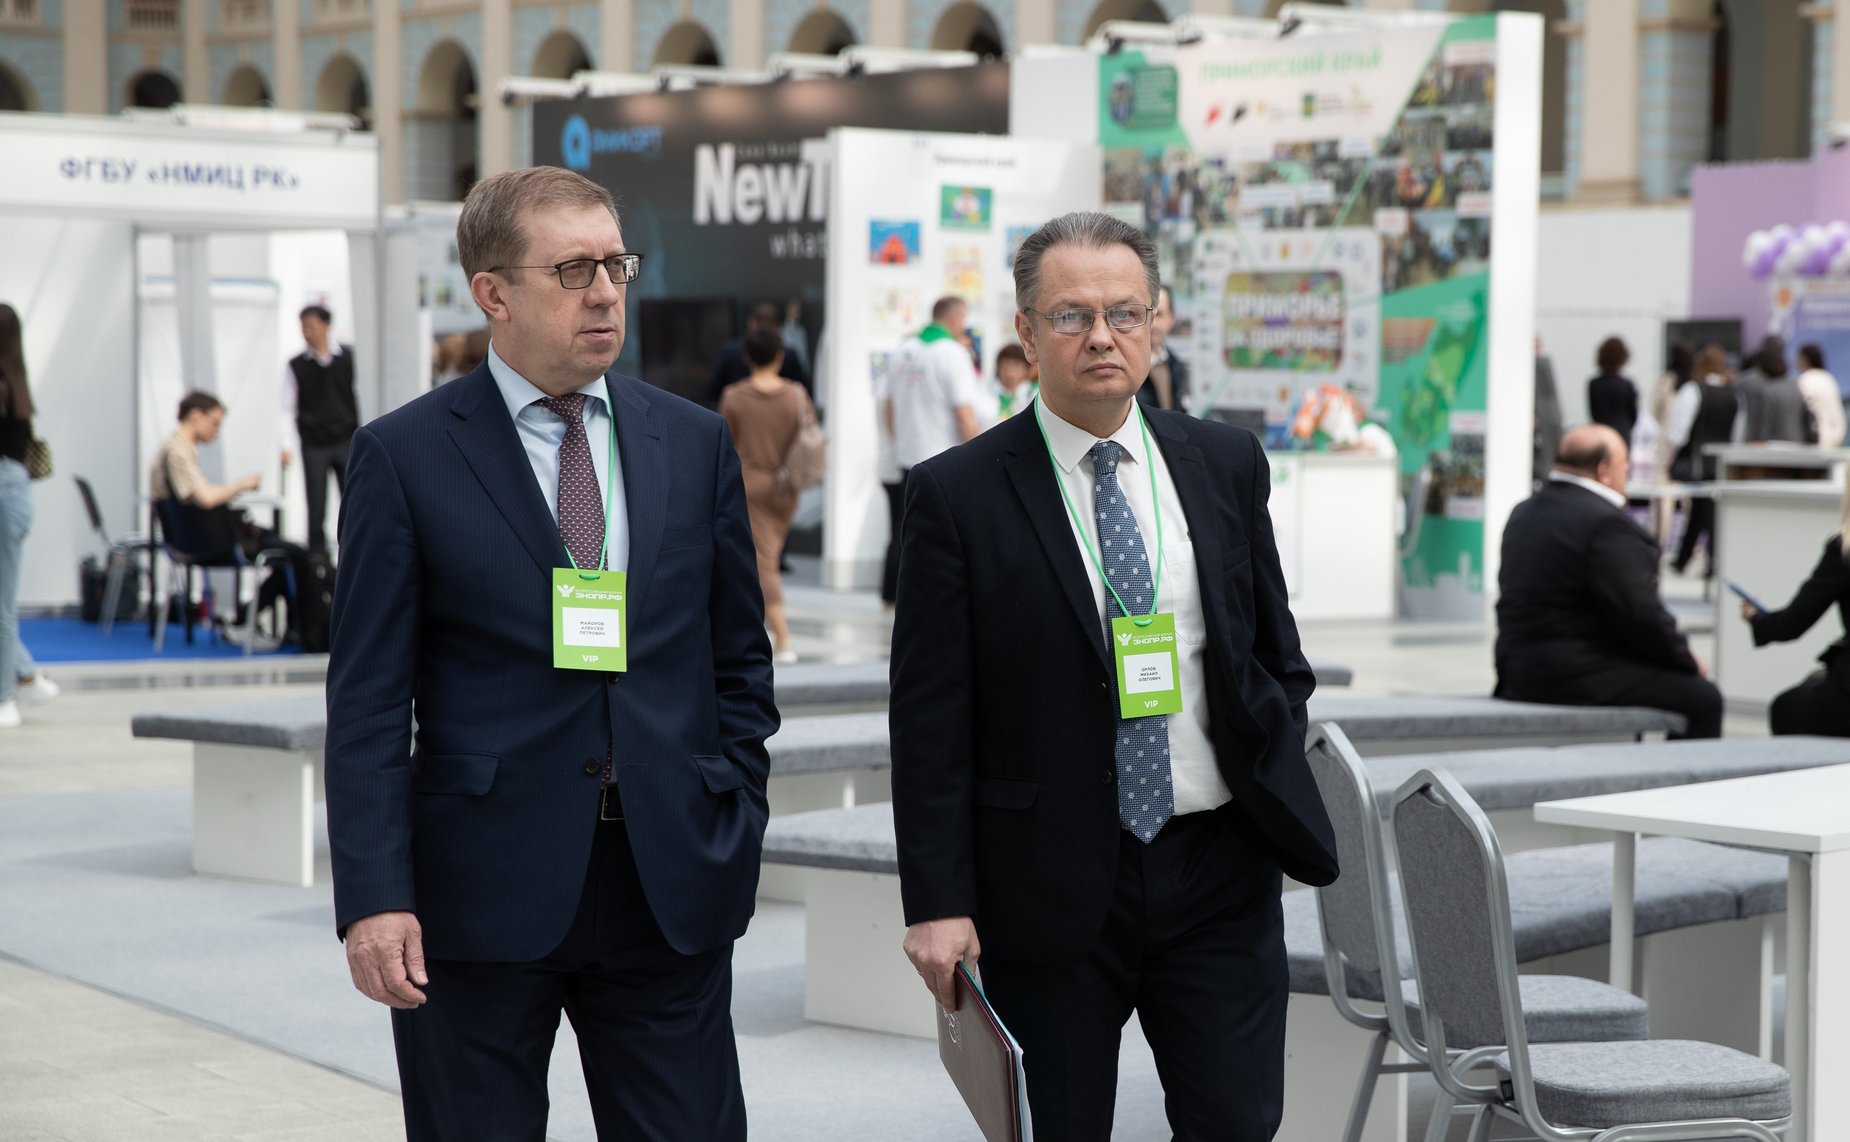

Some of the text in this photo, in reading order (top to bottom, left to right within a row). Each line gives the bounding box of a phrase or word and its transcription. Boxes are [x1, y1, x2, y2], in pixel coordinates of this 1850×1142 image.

[59, 156, 300, 191] ФГБУ «НМИЦ РК»
[582, 654, 599, 662] VIP
[1144, 700, 1159, 708] VIP
